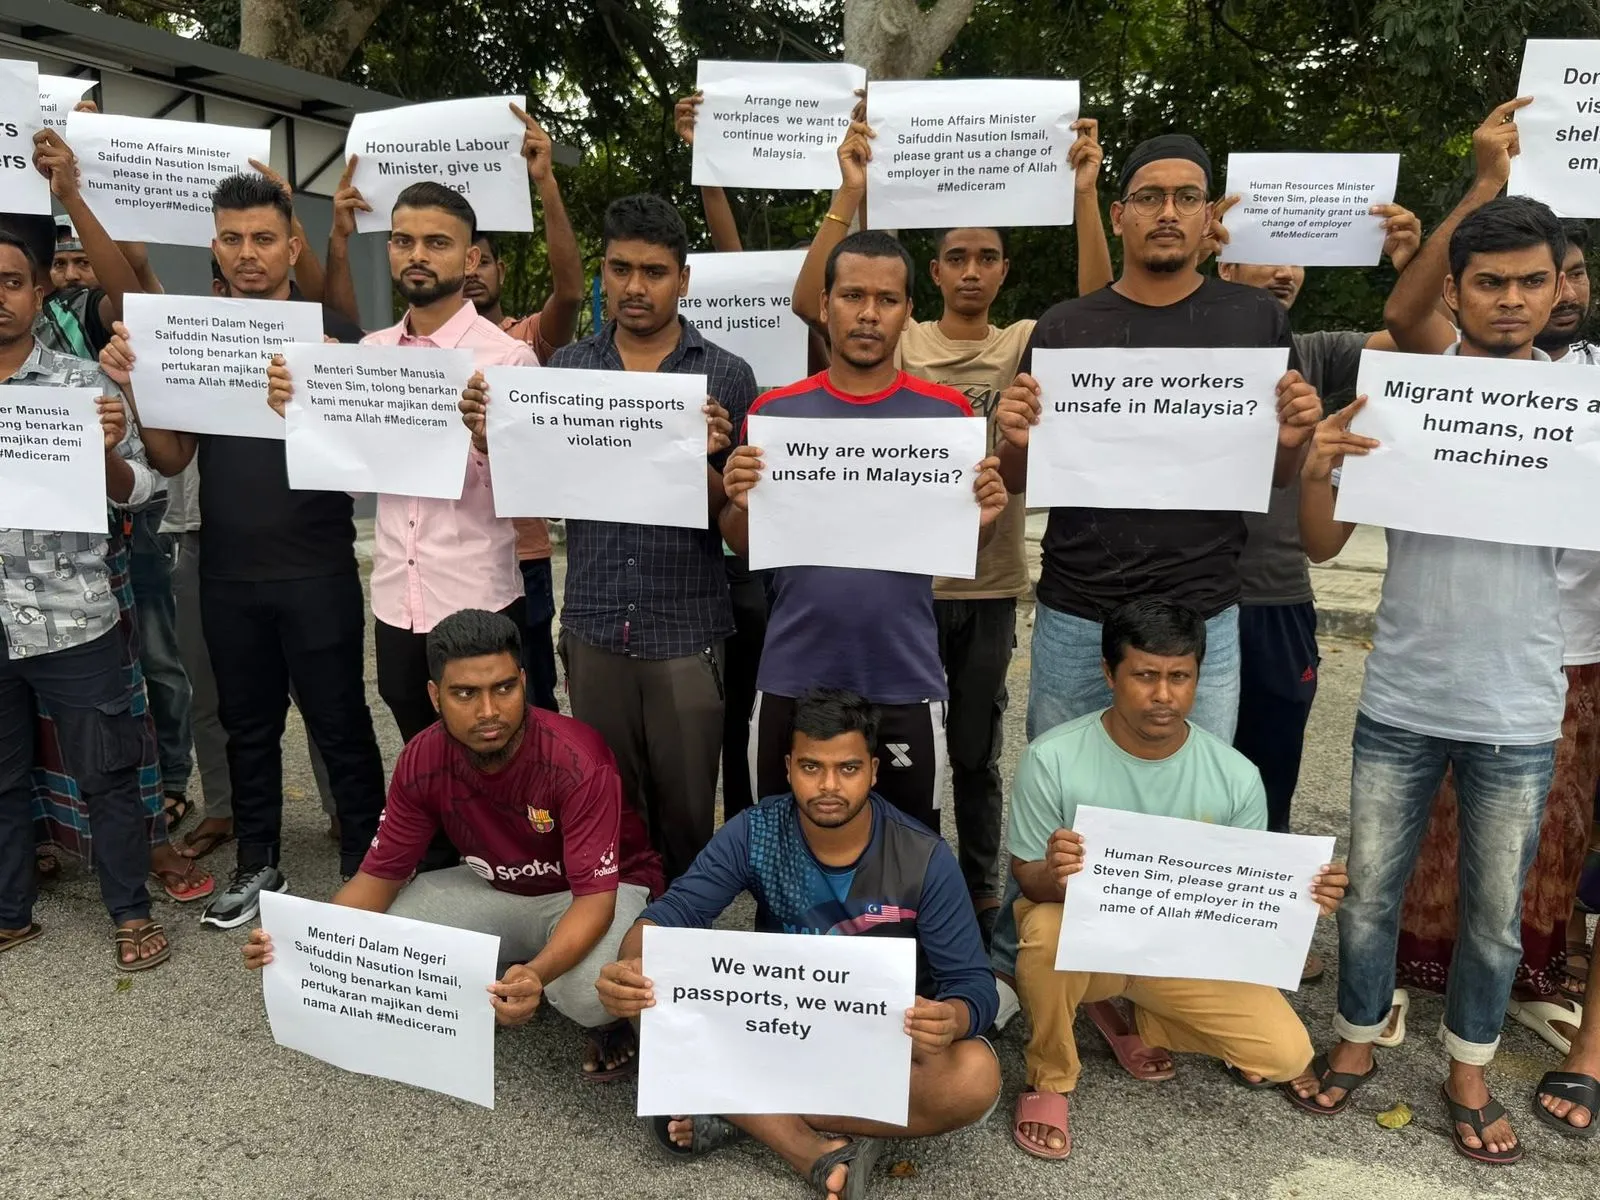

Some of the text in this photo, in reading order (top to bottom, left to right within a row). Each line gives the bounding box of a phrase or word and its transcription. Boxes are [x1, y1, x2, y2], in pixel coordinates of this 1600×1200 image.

[744, 94, 819, 109] Arrange new
[713, 111, 850, 130] workplaces we want to
[911, 114, 1036, 127] Home Affairs Minister
[723, 130, 837, 146] continue working in
[898, 129, 1048, 144] Saifuddin Nasution Ismail,
[111, 138, 230, 158] Home Affairs Minister
[366, 138, 509, 153] Honourable Labour
[98, 152, 204, 170] Saifuddin Nasution
[753, 147, 805, 161] Malaysia.
[894, 146, 1052, 164] please grant us change of
[113, 168, 183, 182] please in the
[378, 161, 501, 176] Minister, give us
[888, 162, 1057, 180] employer in the name of Allah
[88, 180, 140, 194] humanity
[144, 186, 172, 196] grant
[938, 181, 1005, 192] #Mediceram
[1250, 181, 1375, 191] Human Resources Minister
[1253, 194, 1340, 204] Steven Sim, please
[1283, 207, 1326, 218] humanity
[1328, 208, 1352, 217] grant
[1262, 219, 1352, 229] change employer
[1270, 230, 1338, 238] #MeMediceram
[706, 294, 791, 308] workers we
[168, 315, 284, 332] Menteri Dalam Negeri
[727, 316, 780, 332] justice!
[155, 330, 259, 344] Saifuddin Nasution
[169, 346, 257, 359] tolong benarkan
[162, 362, 220, 372] pertukaran
[314, 364, 445, 379] Menteri Sumber Manusia
[166, 377, 226, 386] nama Allah
[307, 380, 457, 396] Steven Sim, tolong benarkan
[1072, 373, 1244, 391] Why are workers
[311, 395, 458, 412] kami menukar majikan demi
[509, 390, 684, 412] Confiscating passports
[1384, 381, 1578, 411] Migrant workers
[16, 406, 69, 416] Manusia
[1055, 398, 1257, 418] unsafe in Malaysia?
[26, 420, 83, 431] benarkan
[324, 413, 447, 427] nama Allah #Mediceram
[532, 412, 663, 431] is a human rights
[1424, 414, 1574, 442] humans, not
[52, 436, 81, 447] demi
[568, 434, 631, 447] violation
[786, 443, 949, 460] Why are workers
[1434, 448, 1548, 469] machines
[773, 466, 962, 486] unsafe in Malaysia?
[1105, 848, 1294, 882] Human Resources Minister
[1094, 864, 1297, 900] Steven Sim, please grant us a
[1103, 884, 1280, 913] change of employer in the
[1100, 904, 1278, 930] name of Allah #Mediceram
[308, 926, 446, 966] Menteri Dalam Negeri
[295, 941, 461, 989] Saifuddin Nasution Ismail,
[712, 957, 850, 984] We want our
[310, 962, 447, 1001] tolong benarkan kami
[302, 978, 458, 1020] pertukaran majikan demi
[674, 987, 886, 1016] passports, we want
[304, 998, 456, 1037] nama Allah #Mediceram
[746, 1018, 811, 1040] safety
